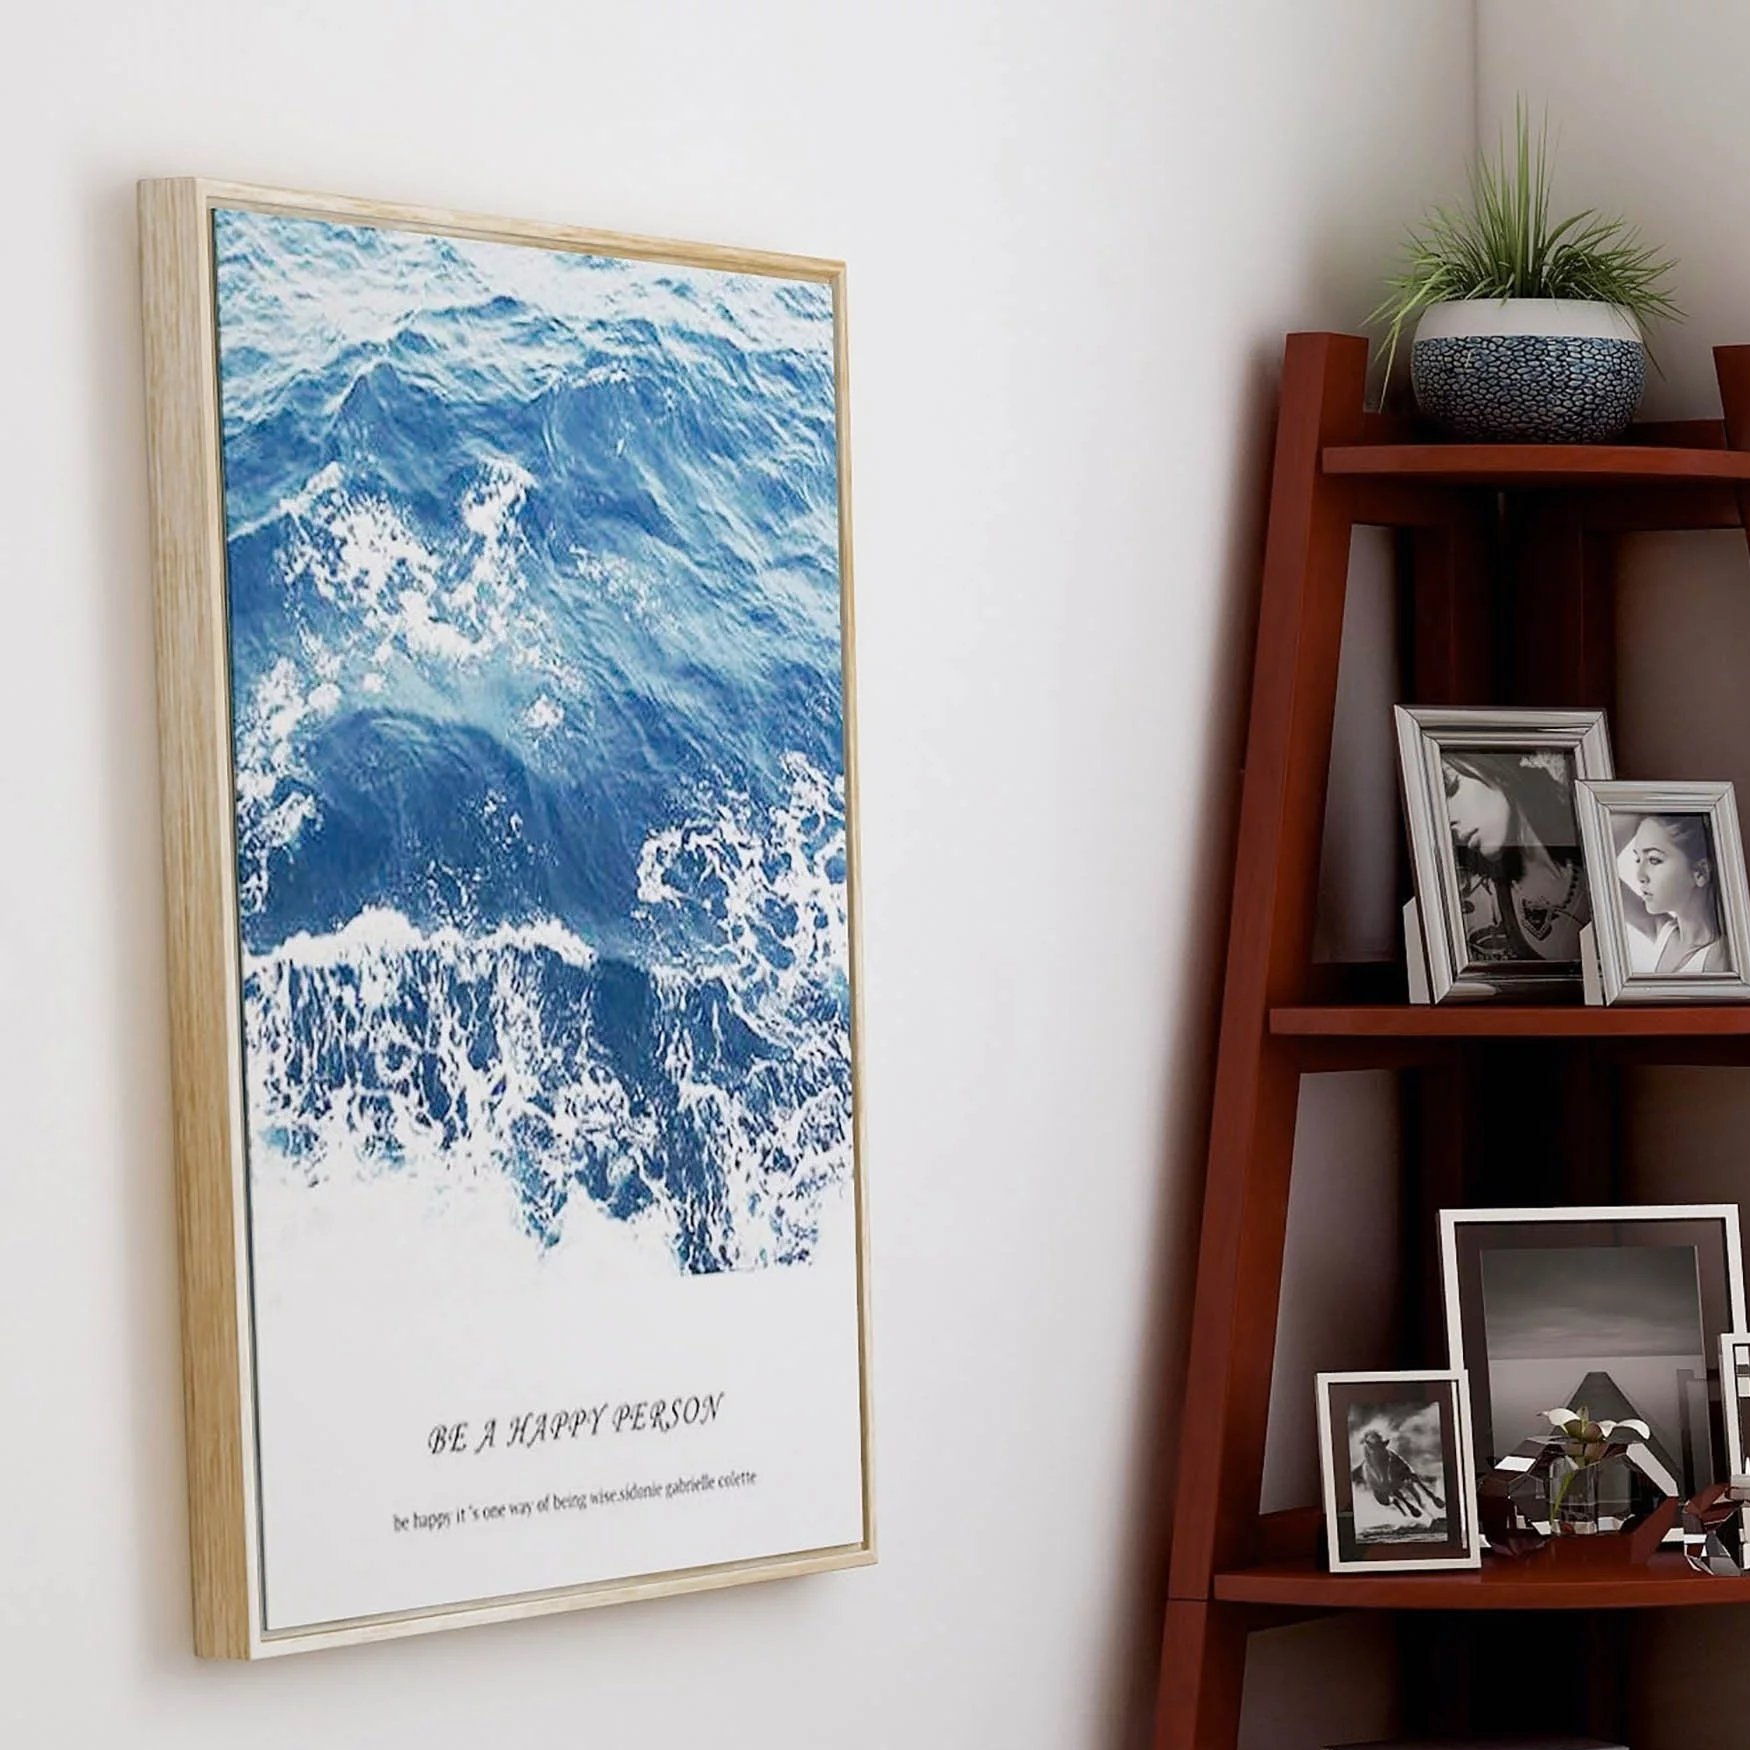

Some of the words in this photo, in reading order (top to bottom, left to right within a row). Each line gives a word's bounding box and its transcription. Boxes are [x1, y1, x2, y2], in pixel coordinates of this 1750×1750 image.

[428, 1421, 468, 1454] BE
[474, 1418, 496, 1454] A
[506, 1402, 608, 1447] HAPPY
[612, 1391, 724, 1432] PERSON
[393, 1514, 409, 1532] be
[413, 1511, 451, 1531] happy
[483, 1505, 505, 1519] one
[508, 1501, 533, 1519] way
[537, 1493, 550, 1512] of
[553, 1492, 587, 1511] being
[665, 1474, 715, 1499] gabrielle
[718, 1469, 757, 1489] colette
